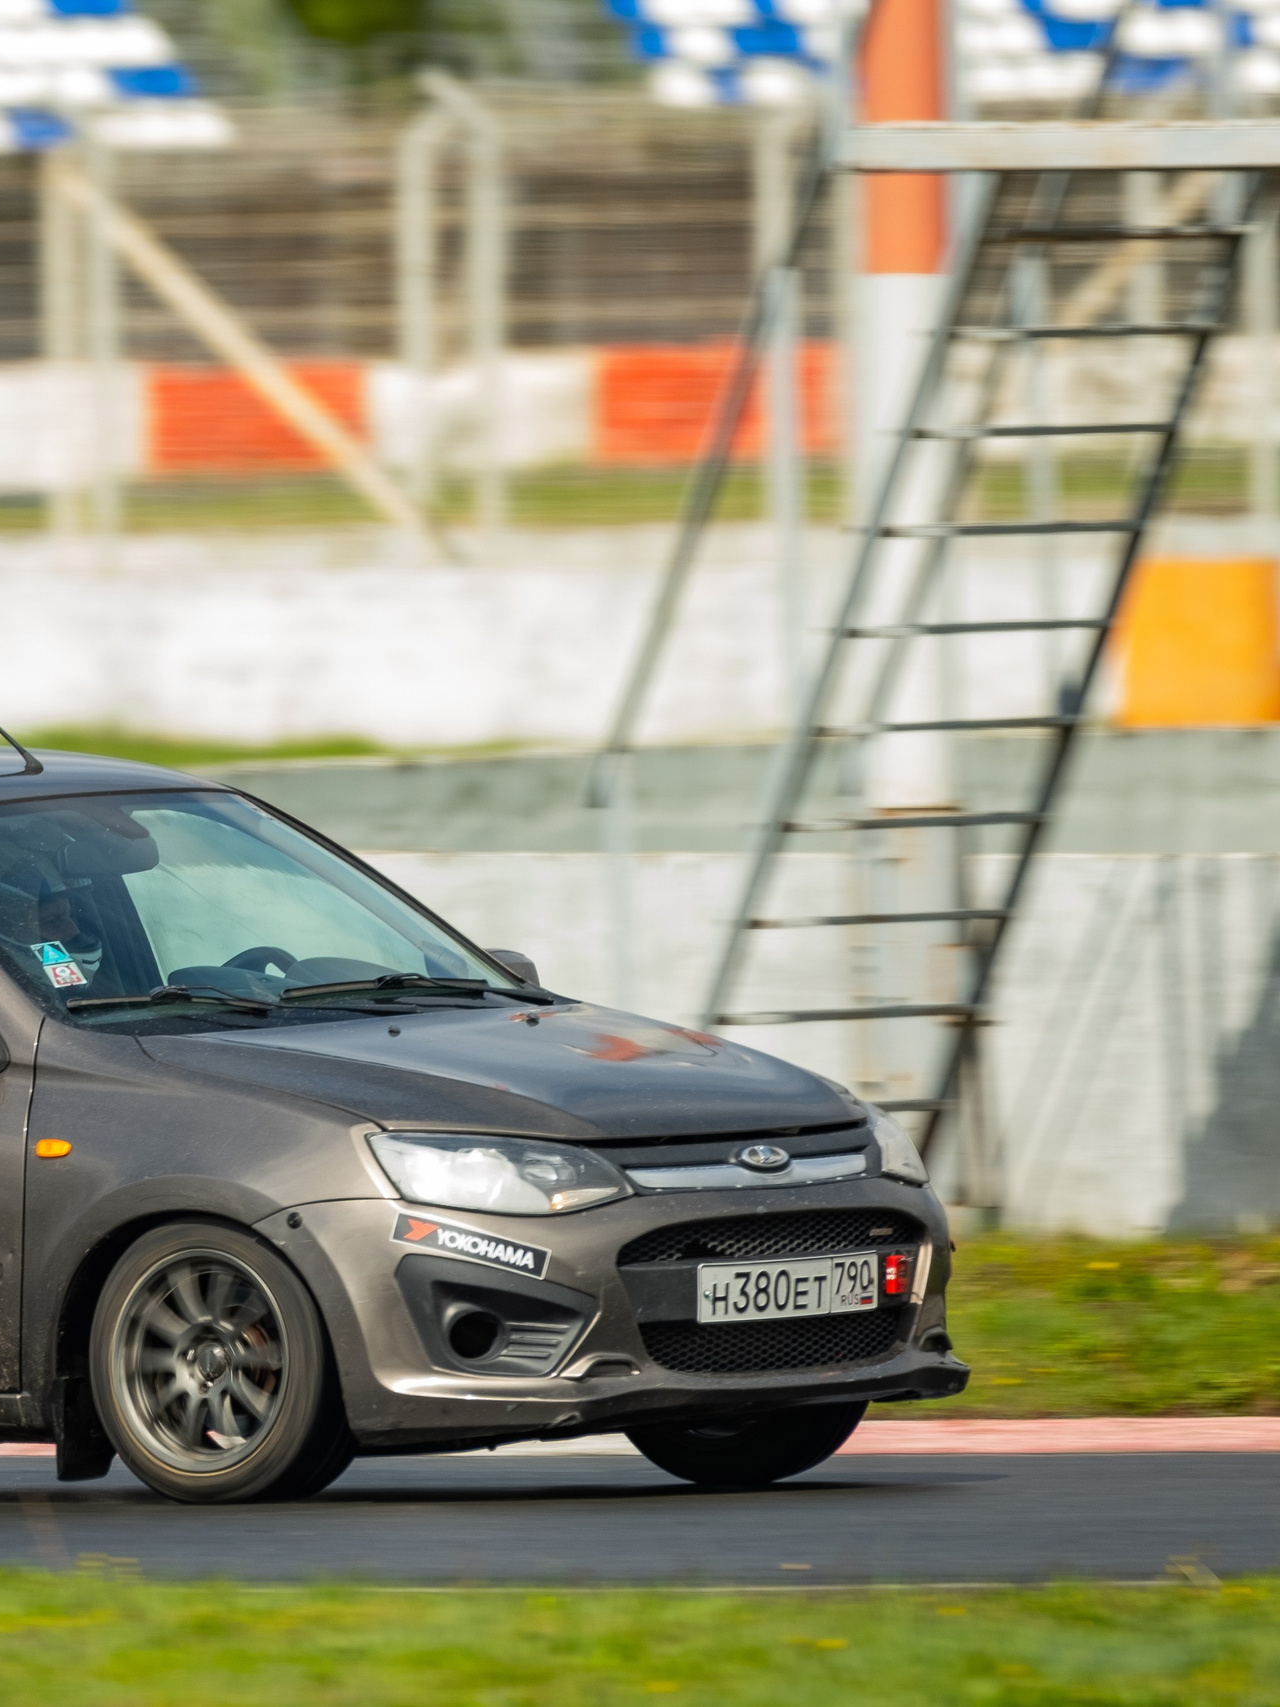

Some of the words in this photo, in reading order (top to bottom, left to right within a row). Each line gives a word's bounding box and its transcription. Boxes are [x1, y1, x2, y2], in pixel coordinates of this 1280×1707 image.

[436, 1227, 535, 1270] YOKOHAMA
[711, 1268, 828, 1316] Н380ЕТ
[834, 1259, 871, 1295] 790
[841, 1294, 860, 1306] RUS
